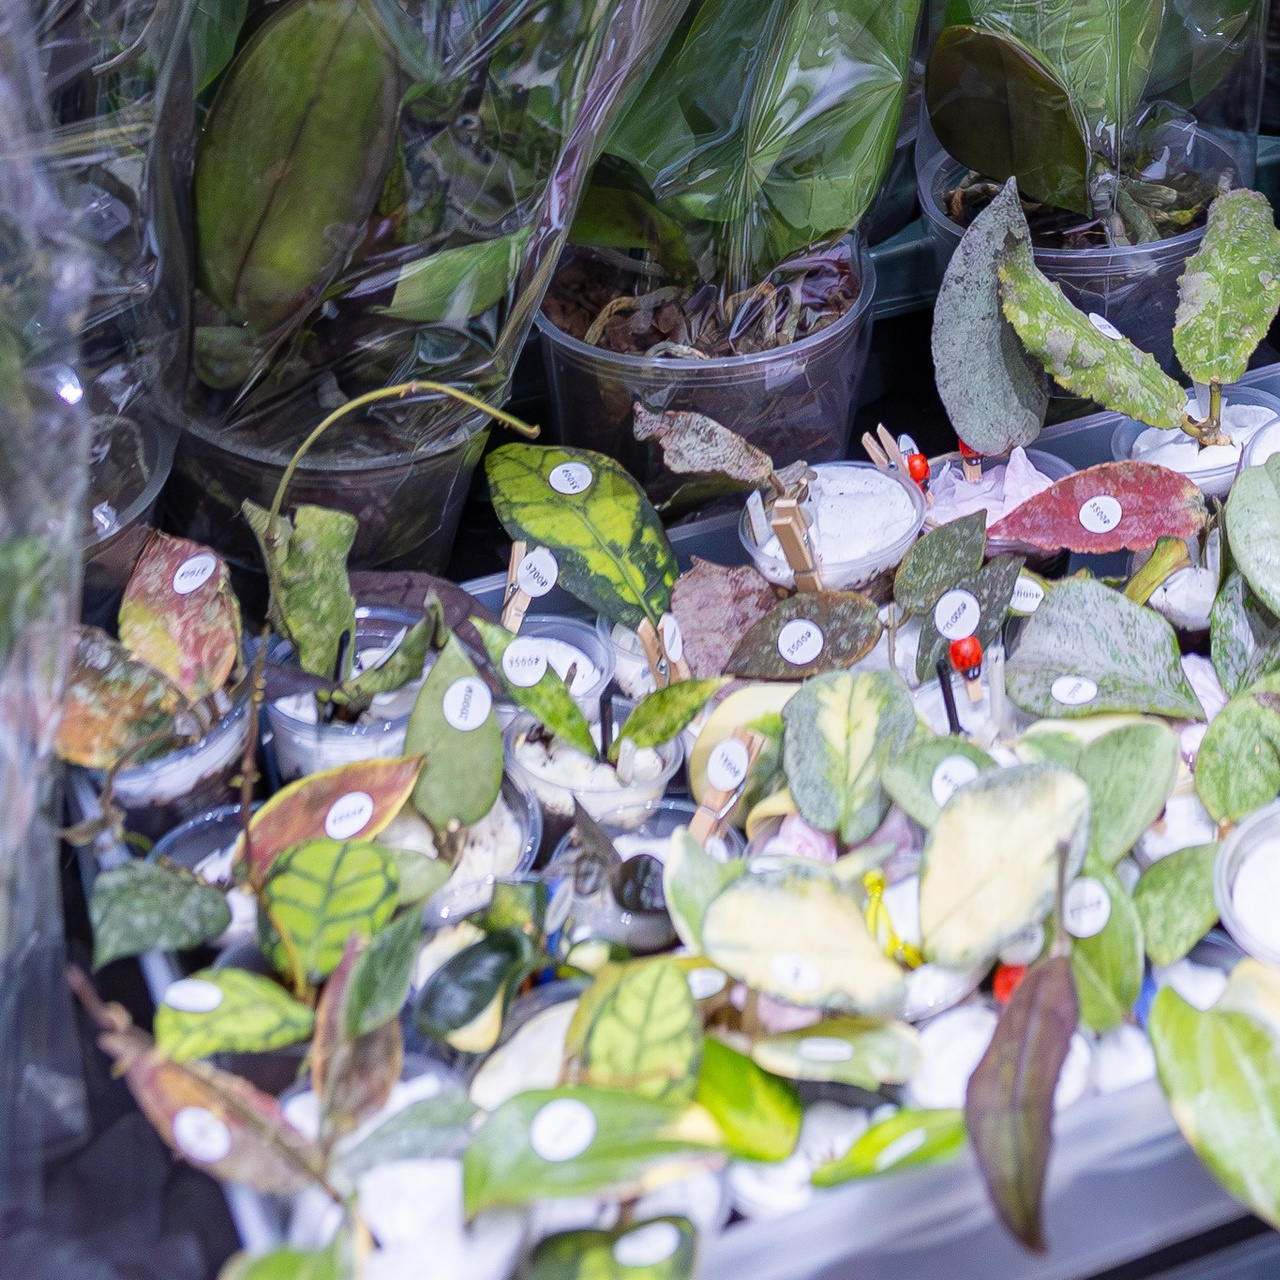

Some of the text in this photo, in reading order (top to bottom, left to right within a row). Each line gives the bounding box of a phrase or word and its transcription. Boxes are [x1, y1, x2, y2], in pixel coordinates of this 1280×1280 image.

[1090, 502, 1110, 525] 3500₽
[525, 562, 548, 587] 3700₽
[787, 630, 812, 656] 3500₽
